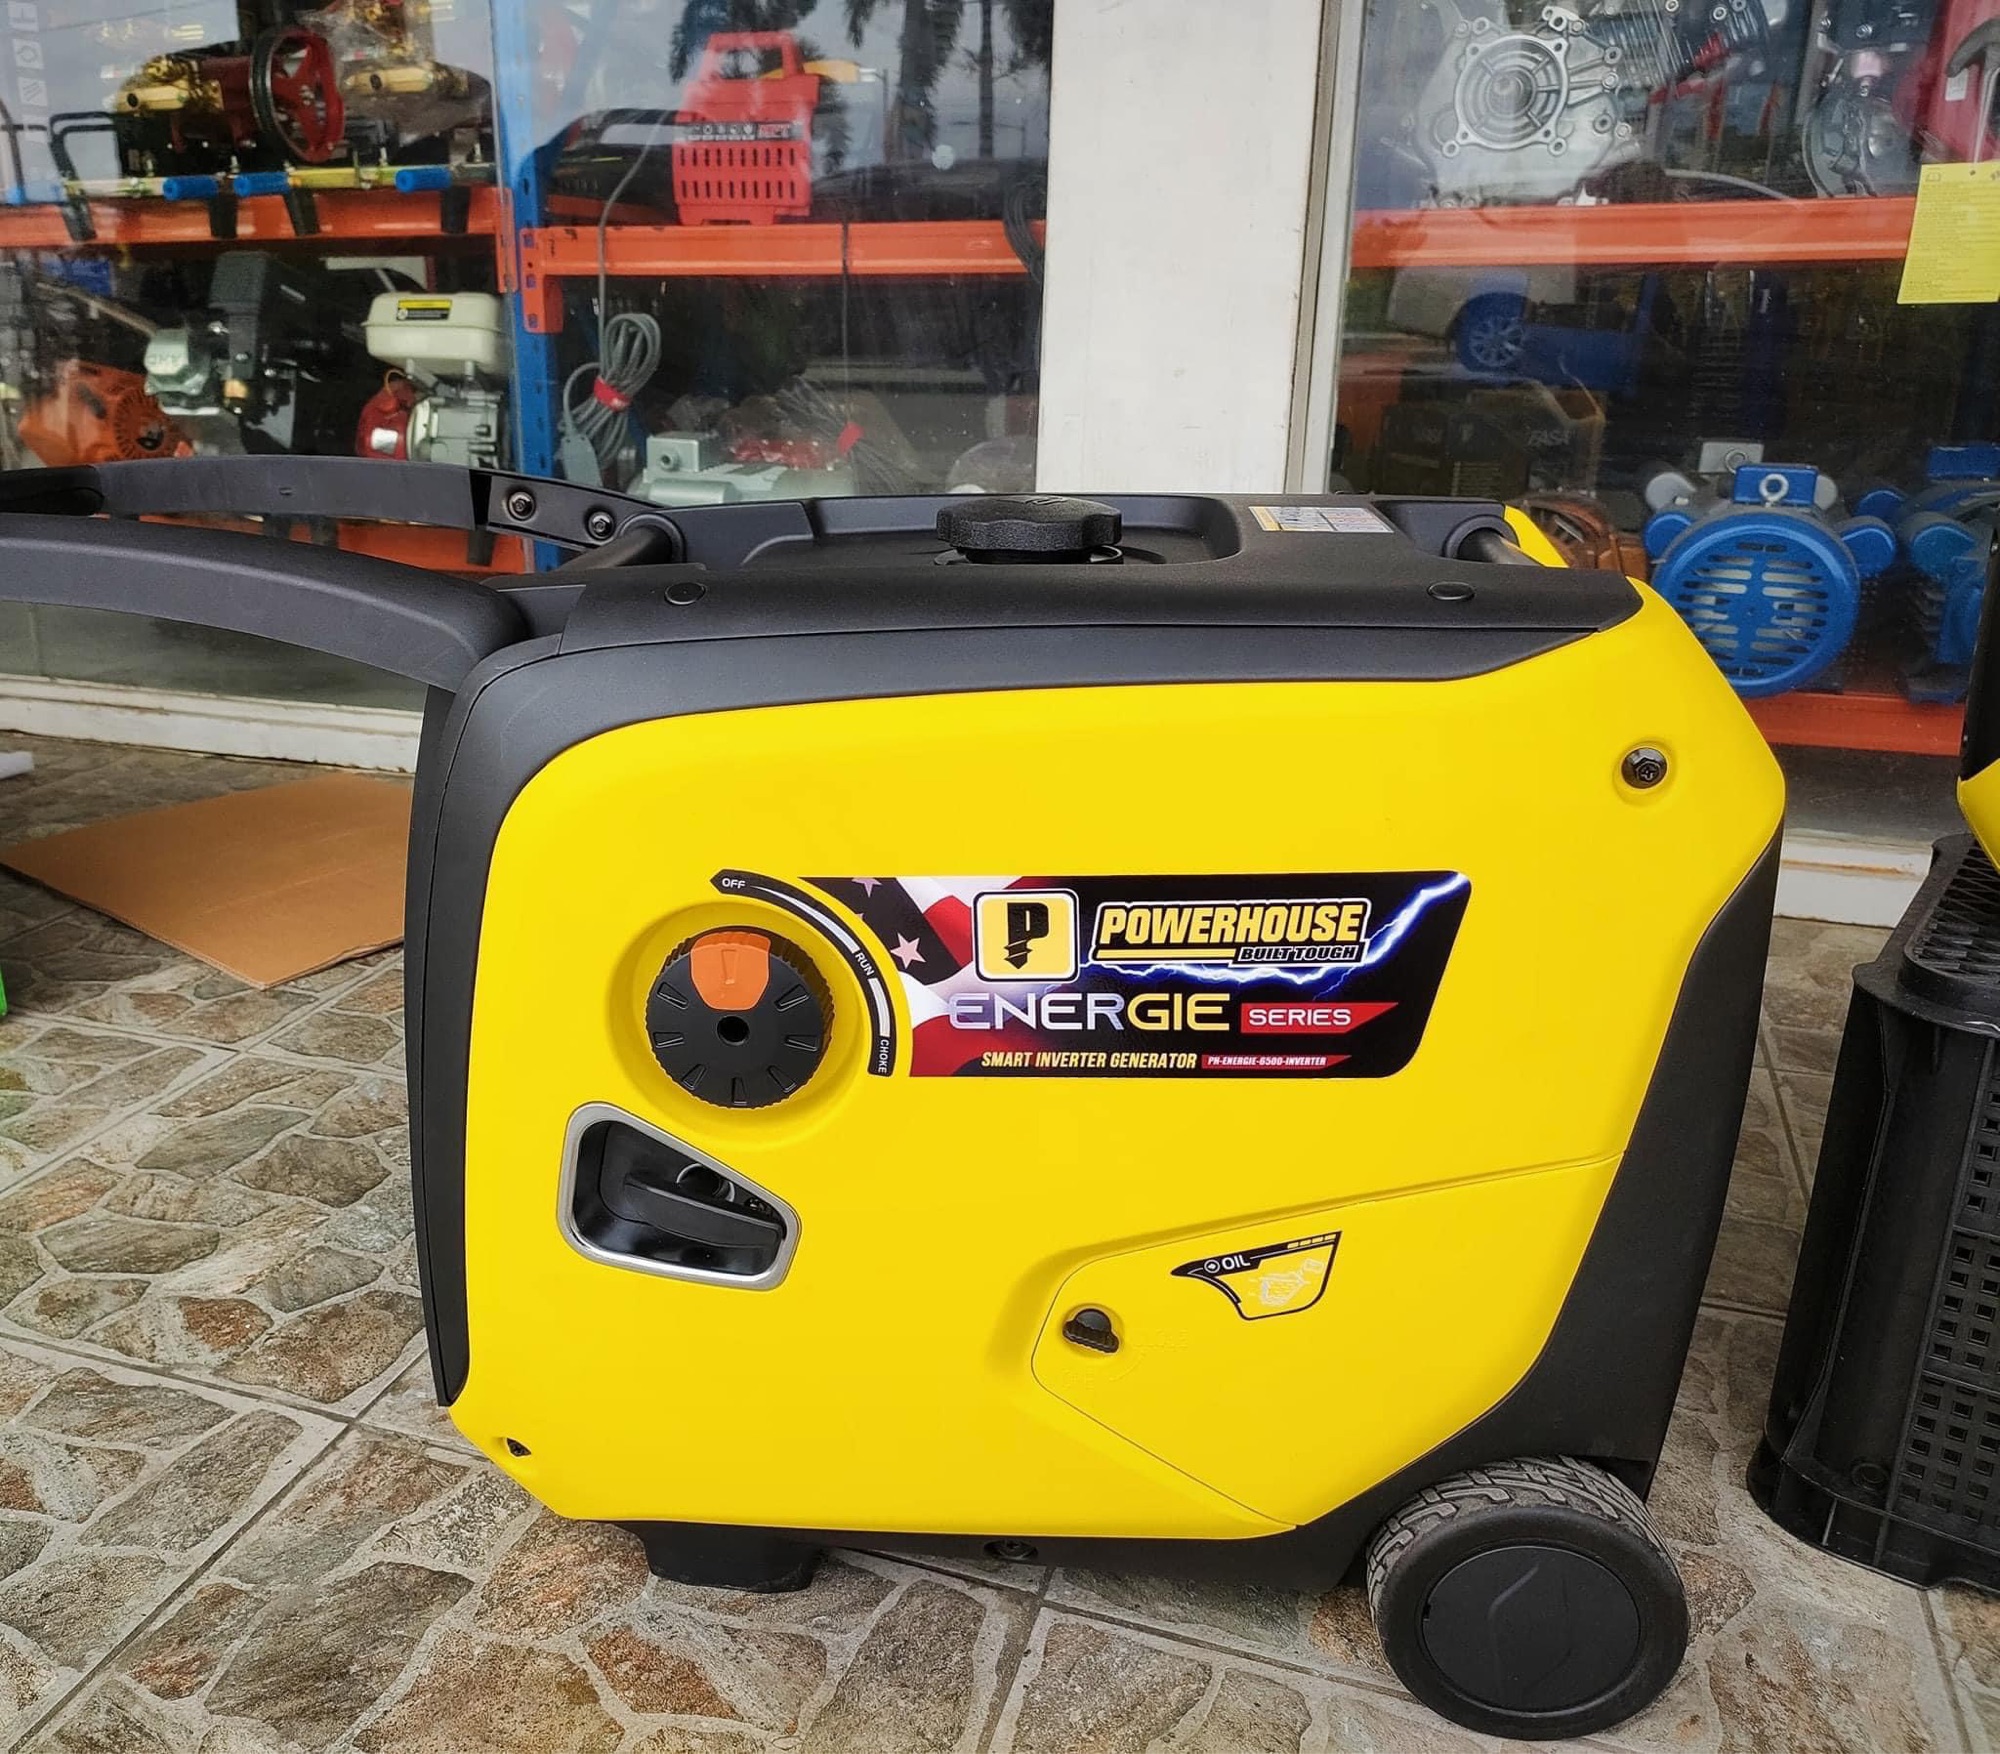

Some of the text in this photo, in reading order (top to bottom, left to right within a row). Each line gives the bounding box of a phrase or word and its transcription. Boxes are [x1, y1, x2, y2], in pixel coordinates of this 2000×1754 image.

[721, 877, 746, 889] OFF
[1004, 902, 1050, 970] P
[1099, 904, 1364, 944] POWERHOUSE
[855, 952, 875, 976] RUN
[1240, 945, 1358, 961] BUILT TOUGH
[949, 992, 1352, 1031] ENERGIE SERIES
[877, 1039, 890, 1074] CHOKE
[981, 1051, 1198, 1070] SMART INVERTER GENERATOR
[1221, 1254, 1250, 1270] OIL
